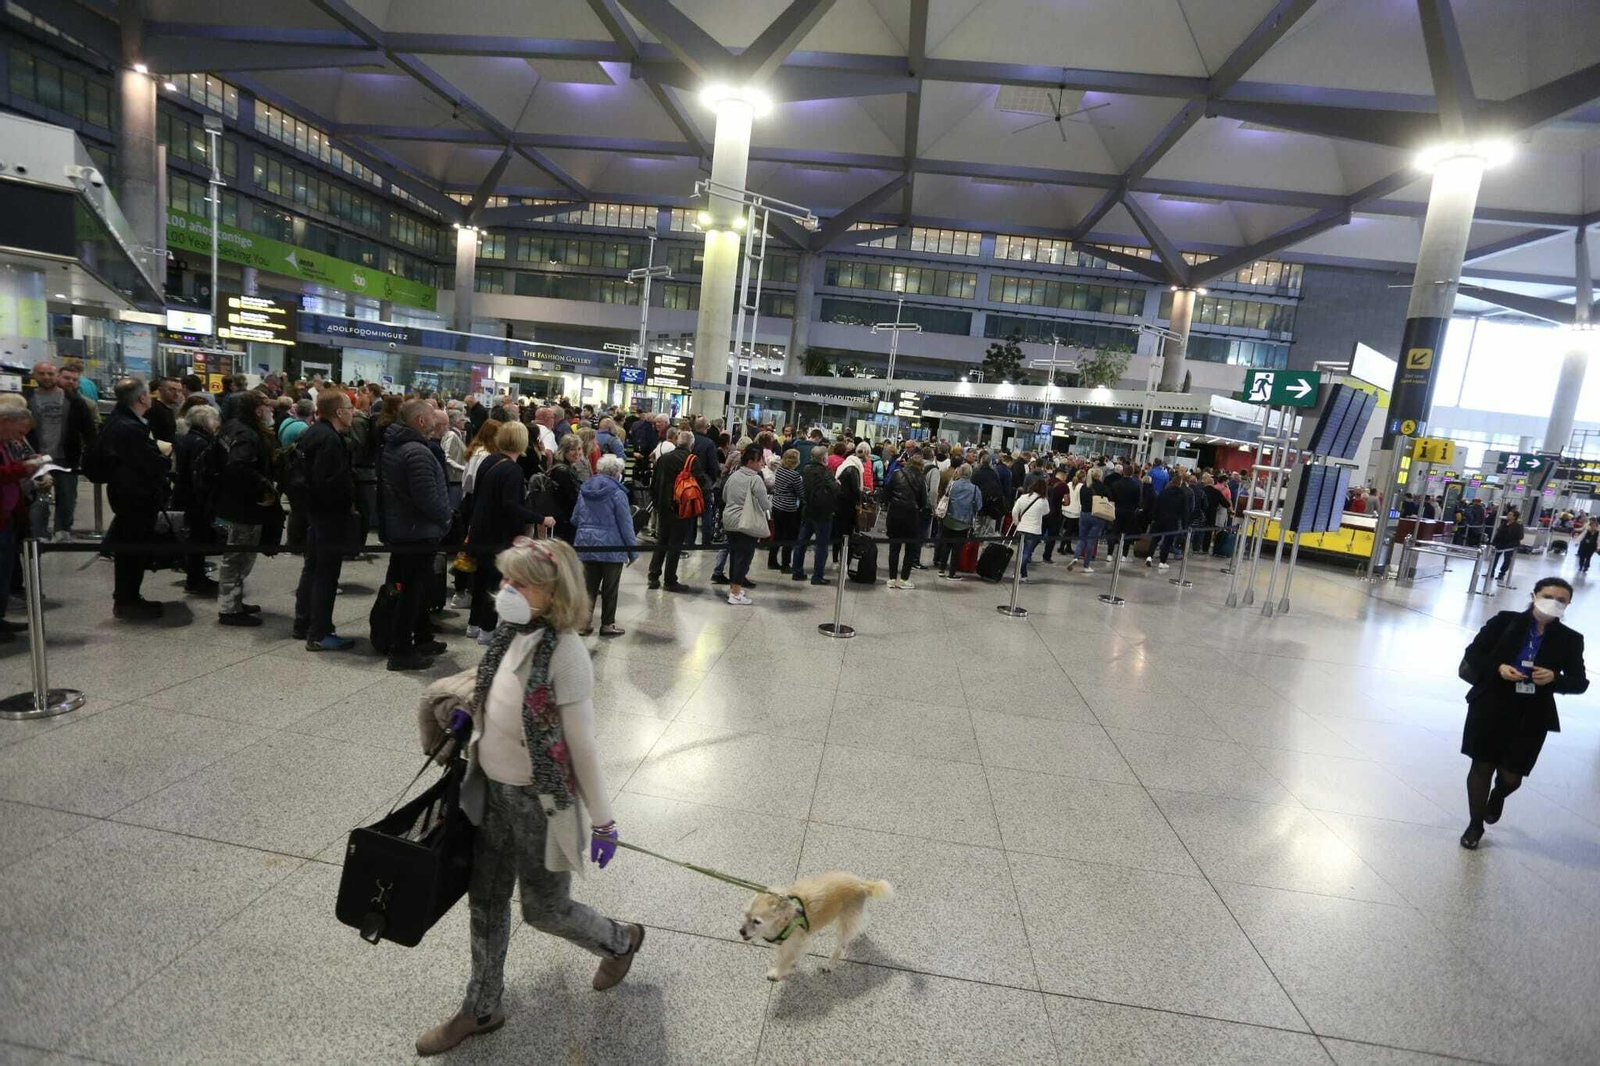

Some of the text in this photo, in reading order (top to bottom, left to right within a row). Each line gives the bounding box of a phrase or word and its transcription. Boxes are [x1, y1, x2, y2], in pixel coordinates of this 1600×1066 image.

[522, 350, 591, 364] THE FASHION GALLERY
